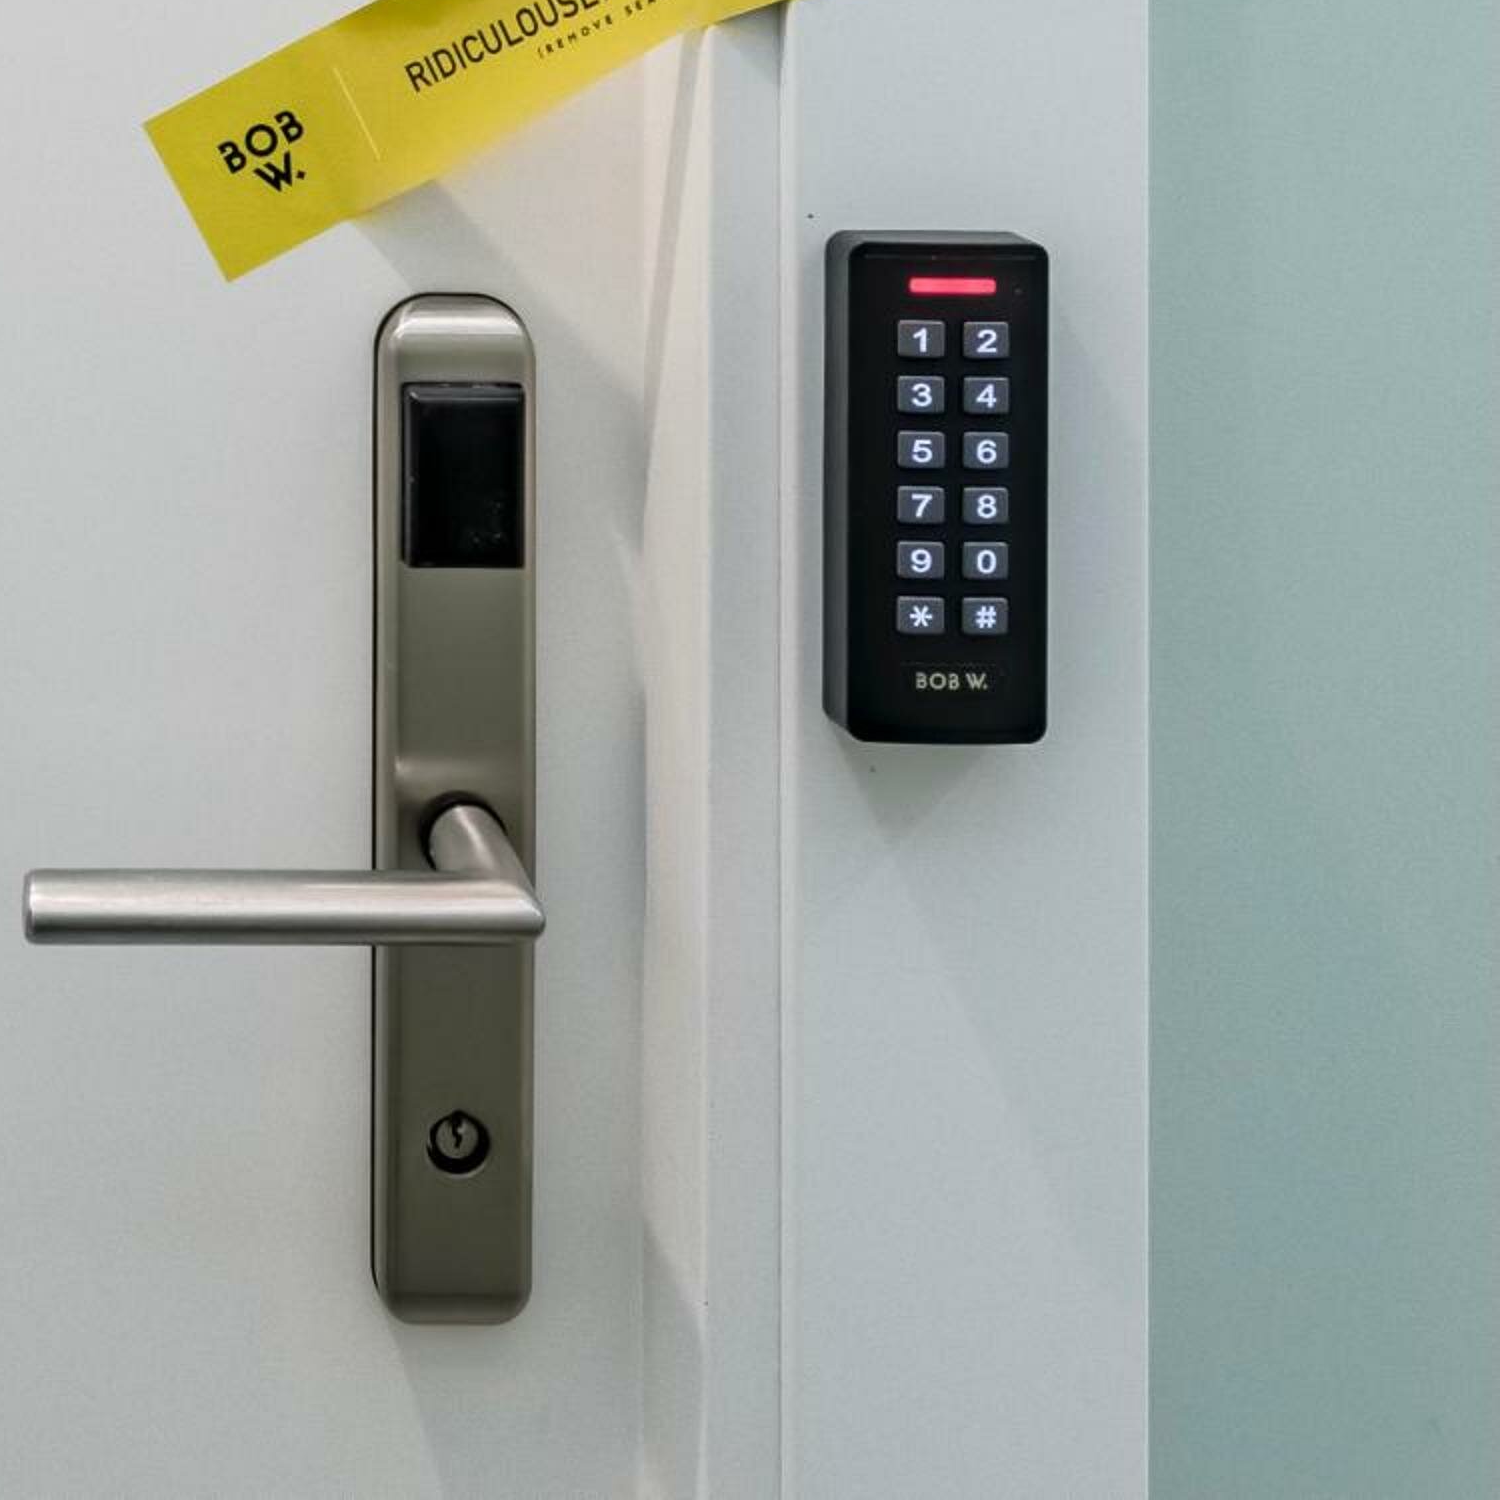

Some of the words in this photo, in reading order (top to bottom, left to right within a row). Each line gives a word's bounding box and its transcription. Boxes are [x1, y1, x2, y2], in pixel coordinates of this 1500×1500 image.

[217, 109, 305, 175] BOB
[253, 150, 307, 193] W.
[912, 327, 929, 353] 1
[976, 327, 998, 353] 2
[911, 382, 933, 408] 3
[976, 382, 998, 408] 4
[911, 438, 933, 464] 5
[976, 438, 998, 464] 6
[911, 493, 933, 518] 7
[976, 493, 998, 518] 8
[911, 548, 933, 574] 9
[976, 548, 998, 574] 0
[976, 605, 998, 629] #
[915, 671, 960, 690] BOB
[965, 671, 988, 690] W.
